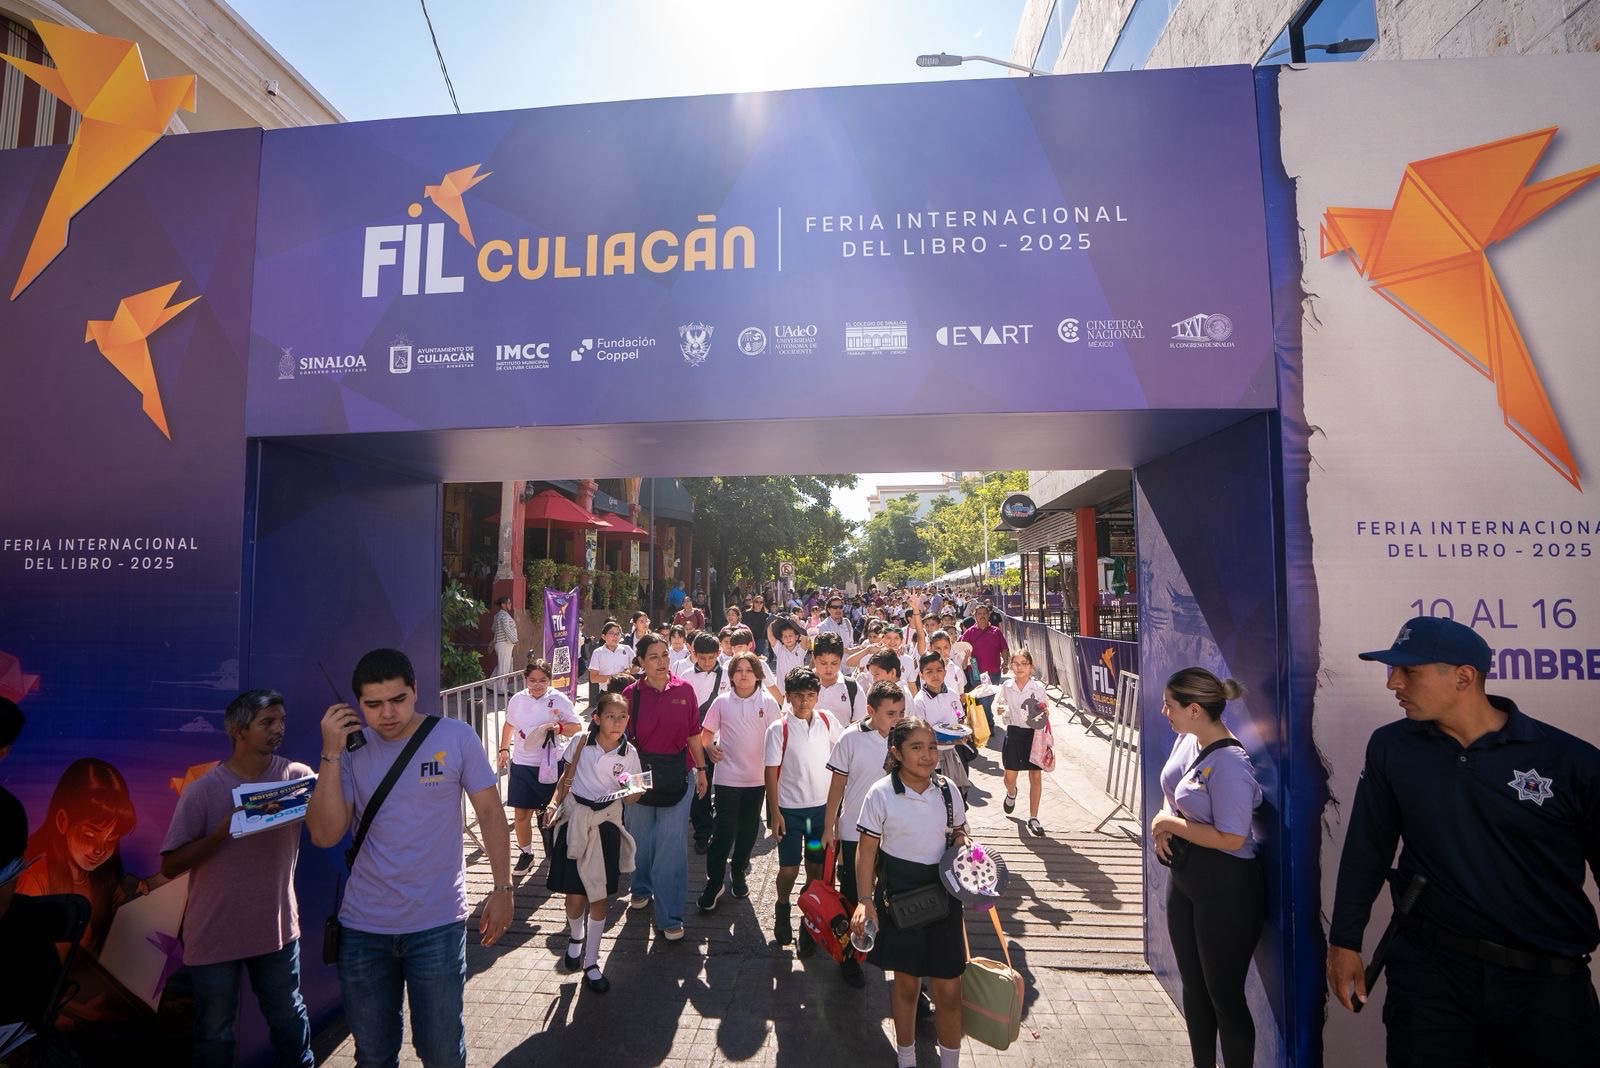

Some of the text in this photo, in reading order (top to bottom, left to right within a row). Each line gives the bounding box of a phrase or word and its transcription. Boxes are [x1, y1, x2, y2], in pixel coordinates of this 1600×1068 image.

[805, 205, 1128, 233] FERIA INTERNACIONAL
[843, 240, 891, 257] DEL
[903, 236, 987, 256] LIBRO
[1019, 233, 1092, 252] 2025
[774, 324, 818, 338] UAdeO
[1086, 319, 1144, 330] CINETECA
[1087, 329, 1145, 340] NACIONAL
[597, 336, 656, 348] Fundación
[417, 352, 475, 364] CULIACÁN
[495, 342, 550, 361] IMCC
[597, 348, 639, 362] Coppel
[299, 354, 367, 370] SINALOA
[1357, 521, 1422, 535] FERIA
[3, 537, 198, 551] FERIA INTERNACIONAL
[1388, 543, 1428, 557] DEL
[1438, 543, 1506, 557] LIBRO
[1532, 543, 1592, 557] 2025
[25, 557, 54, 570] DEL
[61, 557, 112, 570] LIBRO
[130, 556, 174, 570] 2025
[1470, 598, 1518, 629] AL
[1532, 598, 1577, 629] 16
[1091, 660, 1115, 695] FIL
[421, 760, 443, 777] FIL
